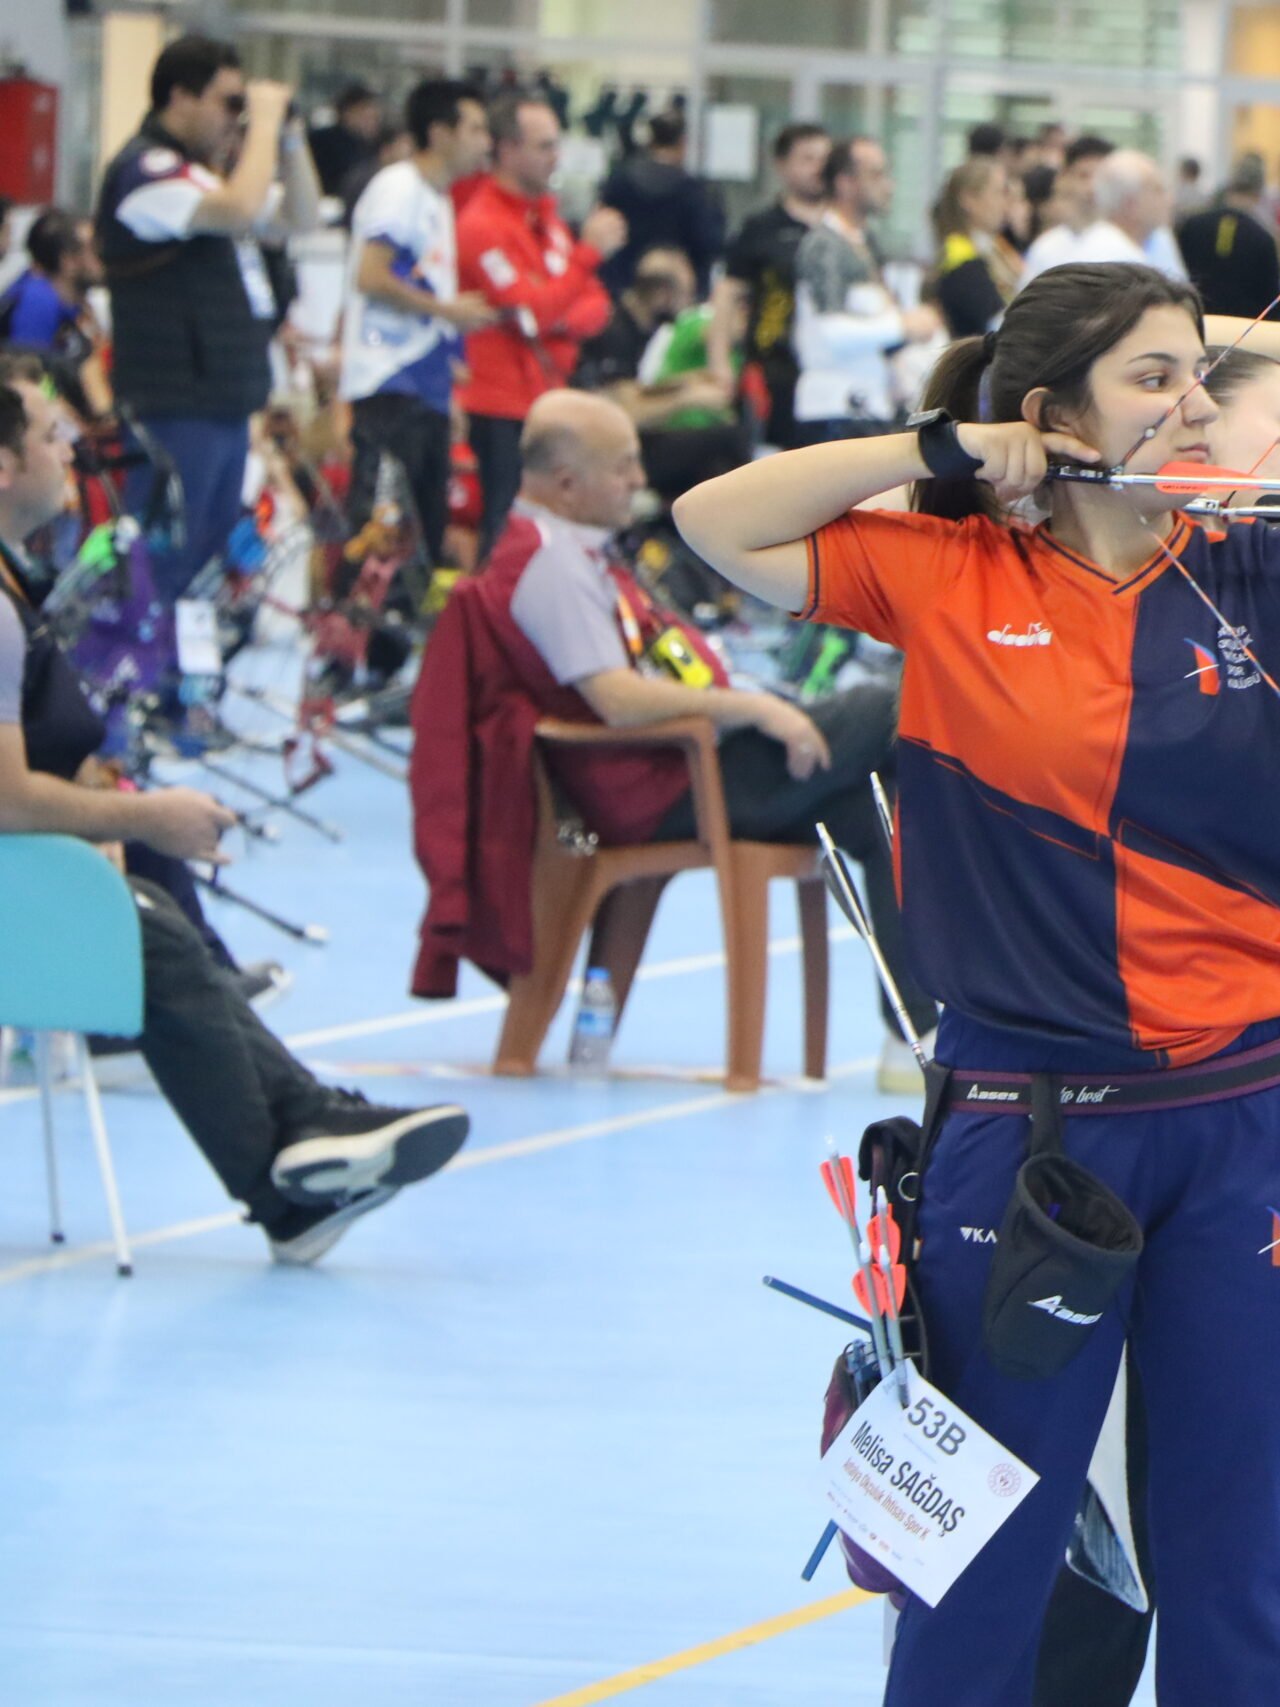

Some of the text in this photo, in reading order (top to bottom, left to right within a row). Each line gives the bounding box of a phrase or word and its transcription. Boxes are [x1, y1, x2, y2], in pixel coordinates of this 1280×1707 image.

[907, 1397, 967, 1456] 53B
[851, 1420, 895, 1476] Melisa
[890, 1460, 966, 1538] SAĞDAŞ
[903, 1514, 924, 1535] Spor
[919, 1530, 929, 1541] K
